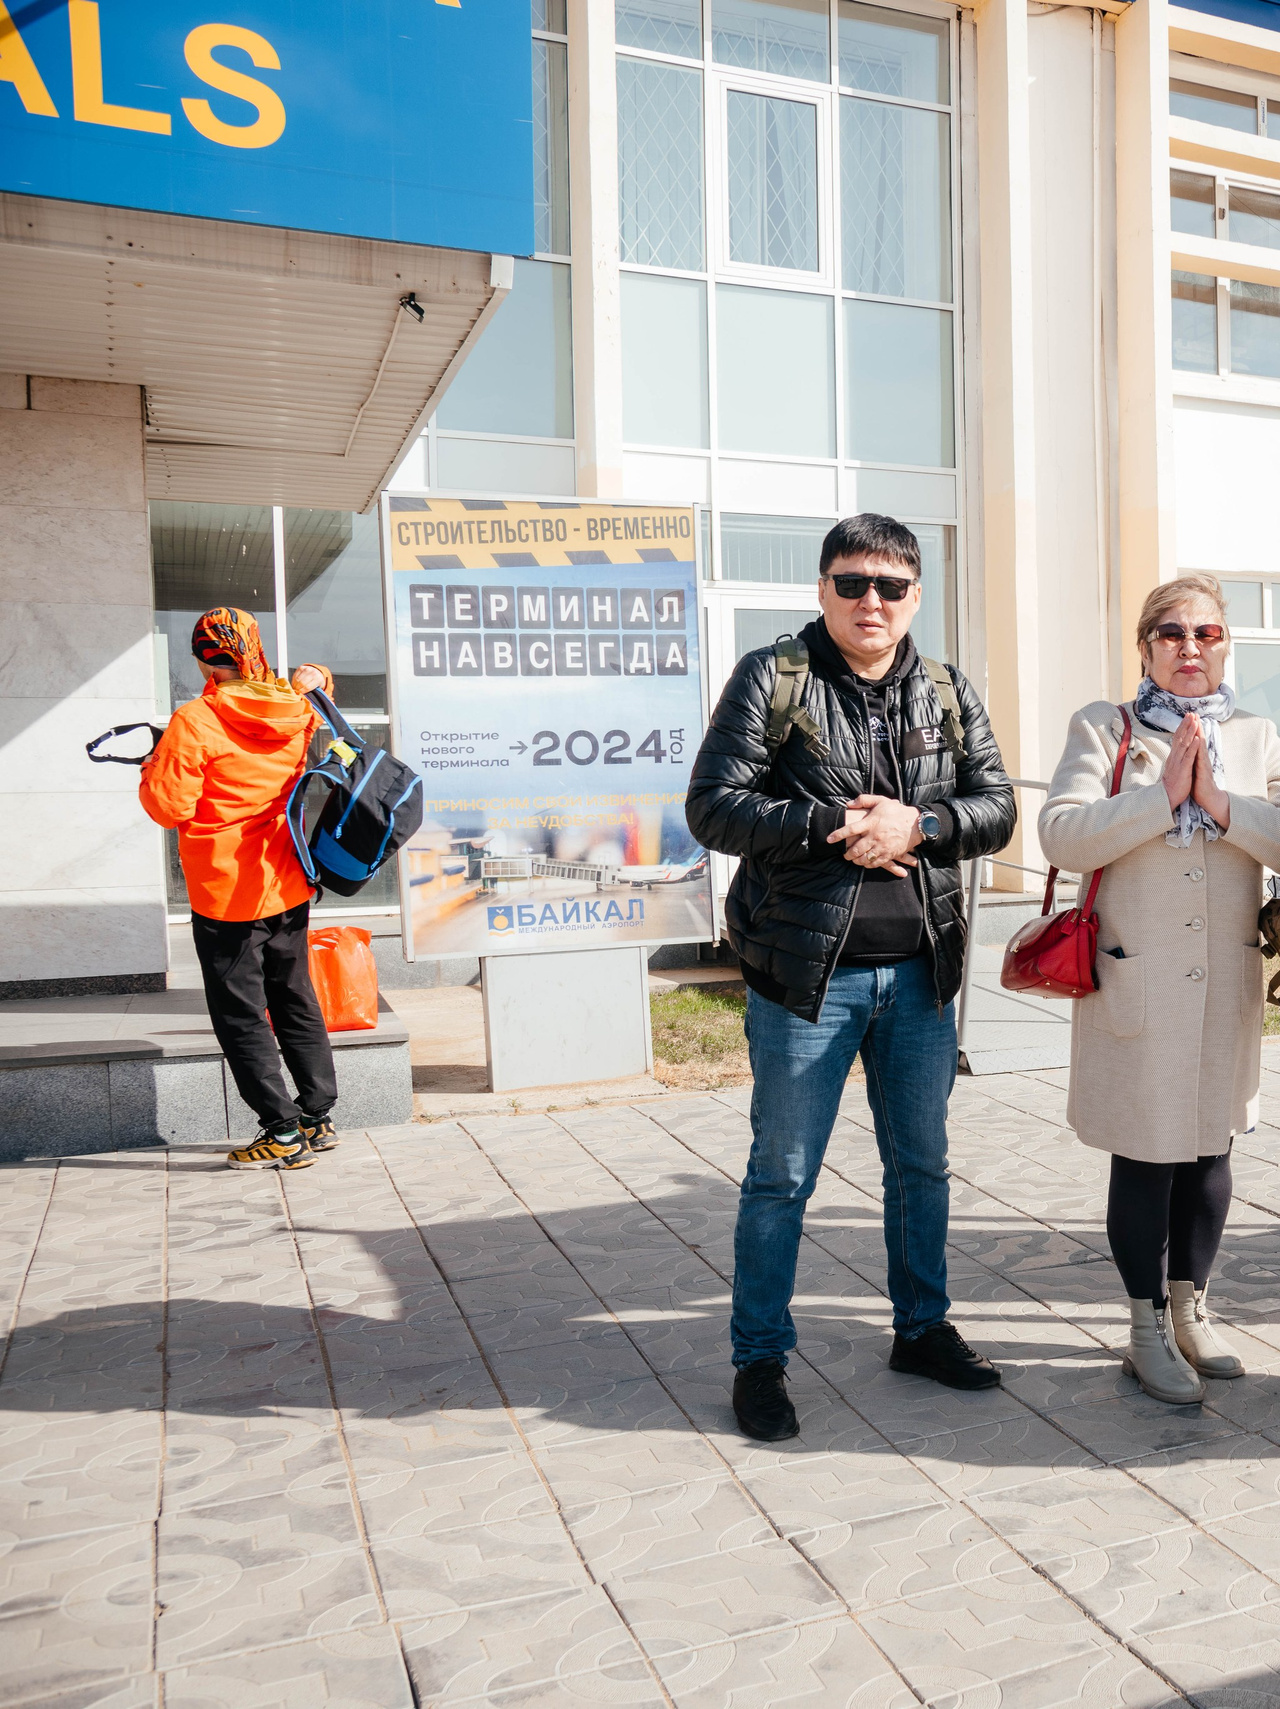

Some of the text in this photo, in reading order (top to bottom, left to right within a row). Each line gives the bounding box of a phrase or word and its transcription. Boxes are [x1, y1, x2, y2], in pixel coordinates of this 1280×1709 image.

[397, 518, 568, 546] СТРОИТЕЛЬСТВО
[586, 515, 691, 541] ВРЕМЕННО
[415, 592, 680, 623] ТЕРМИНАЛ
[419, 641, 685, 674] НАВСЕГДА
[420, 730, 500, 743] Открытие
[921, 727, 948, 743] EA
[421, 744, 475, 756] нового
[532, 728, 667, 767] 2024
[669, 728, 685, 764] ГОД
[421, 757, 510, 771] терминала
[425, 792, 688, 812] ПРИНОСИМ СВОИ ИЗВИНЕНИЯ
[487, 812, 634, 830] ЗА НЕУДОБСТВА!
[517, 897, 645, 927] БАЙКАЛ
[518, 920, 645, 934] МЕЖДУНАРОДНЫЙ АЭРОПОРТ
